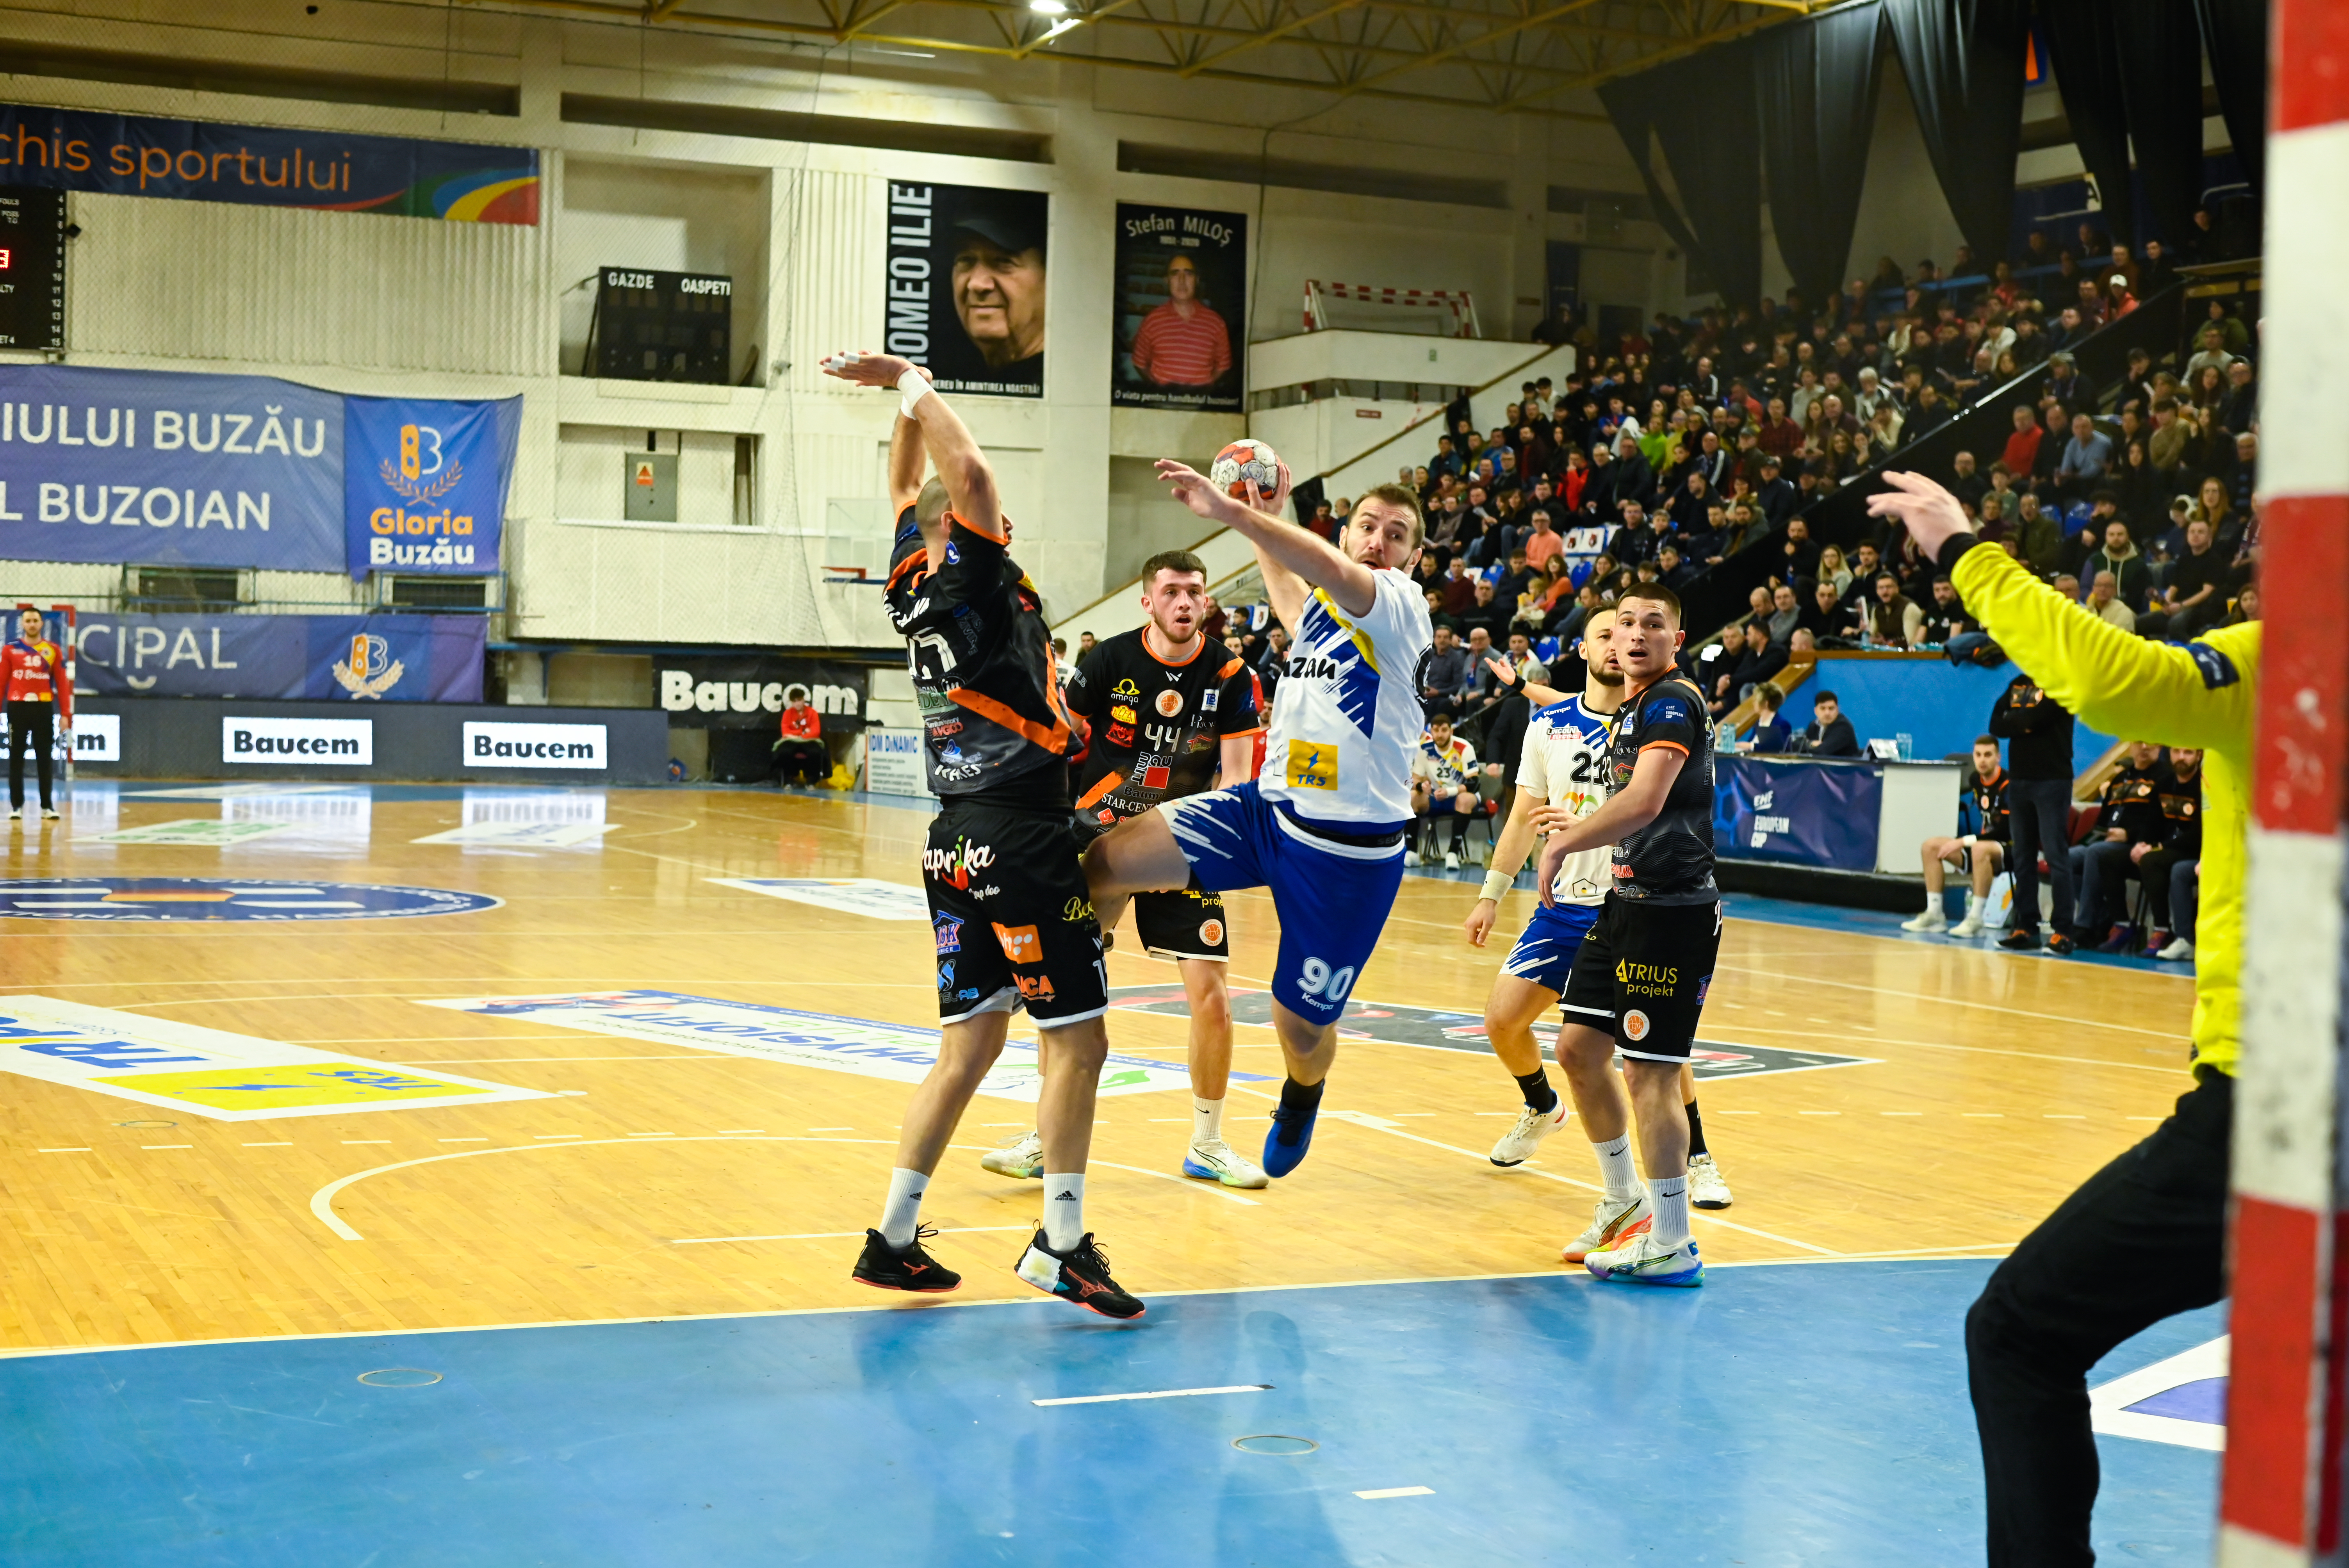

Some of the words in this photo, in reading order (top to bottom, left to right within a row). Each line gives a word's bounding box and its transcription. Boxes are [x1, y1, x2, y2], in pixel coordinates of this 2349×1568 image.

[110, 142, 350, 192] sportului
[891, 184, 932, 248] ILIE
[608, 272, 654, 289] GAZDE
[681, 278, 731, 296] OASPETI
[3, 402, 136, 448] IULUI
[154, 405, 326, 458] BUZĂU
[39, 481, 270, 531] BUZOIAN
[369, 508, 473, 535] Gloria
[369, 537, 475, 565] Buzău
[1111, 693, 1139, 706] omega
[1113, 708, 1133, 722] ALFA
[1543, 706, 1571, 716] Kempa
[233, 731, 359, 754] Baucem
[474, 735, 593, 759] Baucem
[1145, 723, 1181, 753] 44
[1297, 774, 1326, 786] TRS
[1436, 767, 1450, 778] 23
[1602, 755, 1615, 787] 23
[1101, 793, 1166, 813] STAR-CENT
[1124, 786, 1166, 800] Baumit
[1751, 832, 1767, 848] CUP
[1297, 957, 1355, 1002] 90
[1627, 984, 1673, 998] projekt
[1301, 992, 1334, 1012] Kempa
[600, 1013, 937, 1065] PHYSIOFIT
[763, 1021, 939, 1047] PLUS
[306, 1071, 444, 1090] TRS
